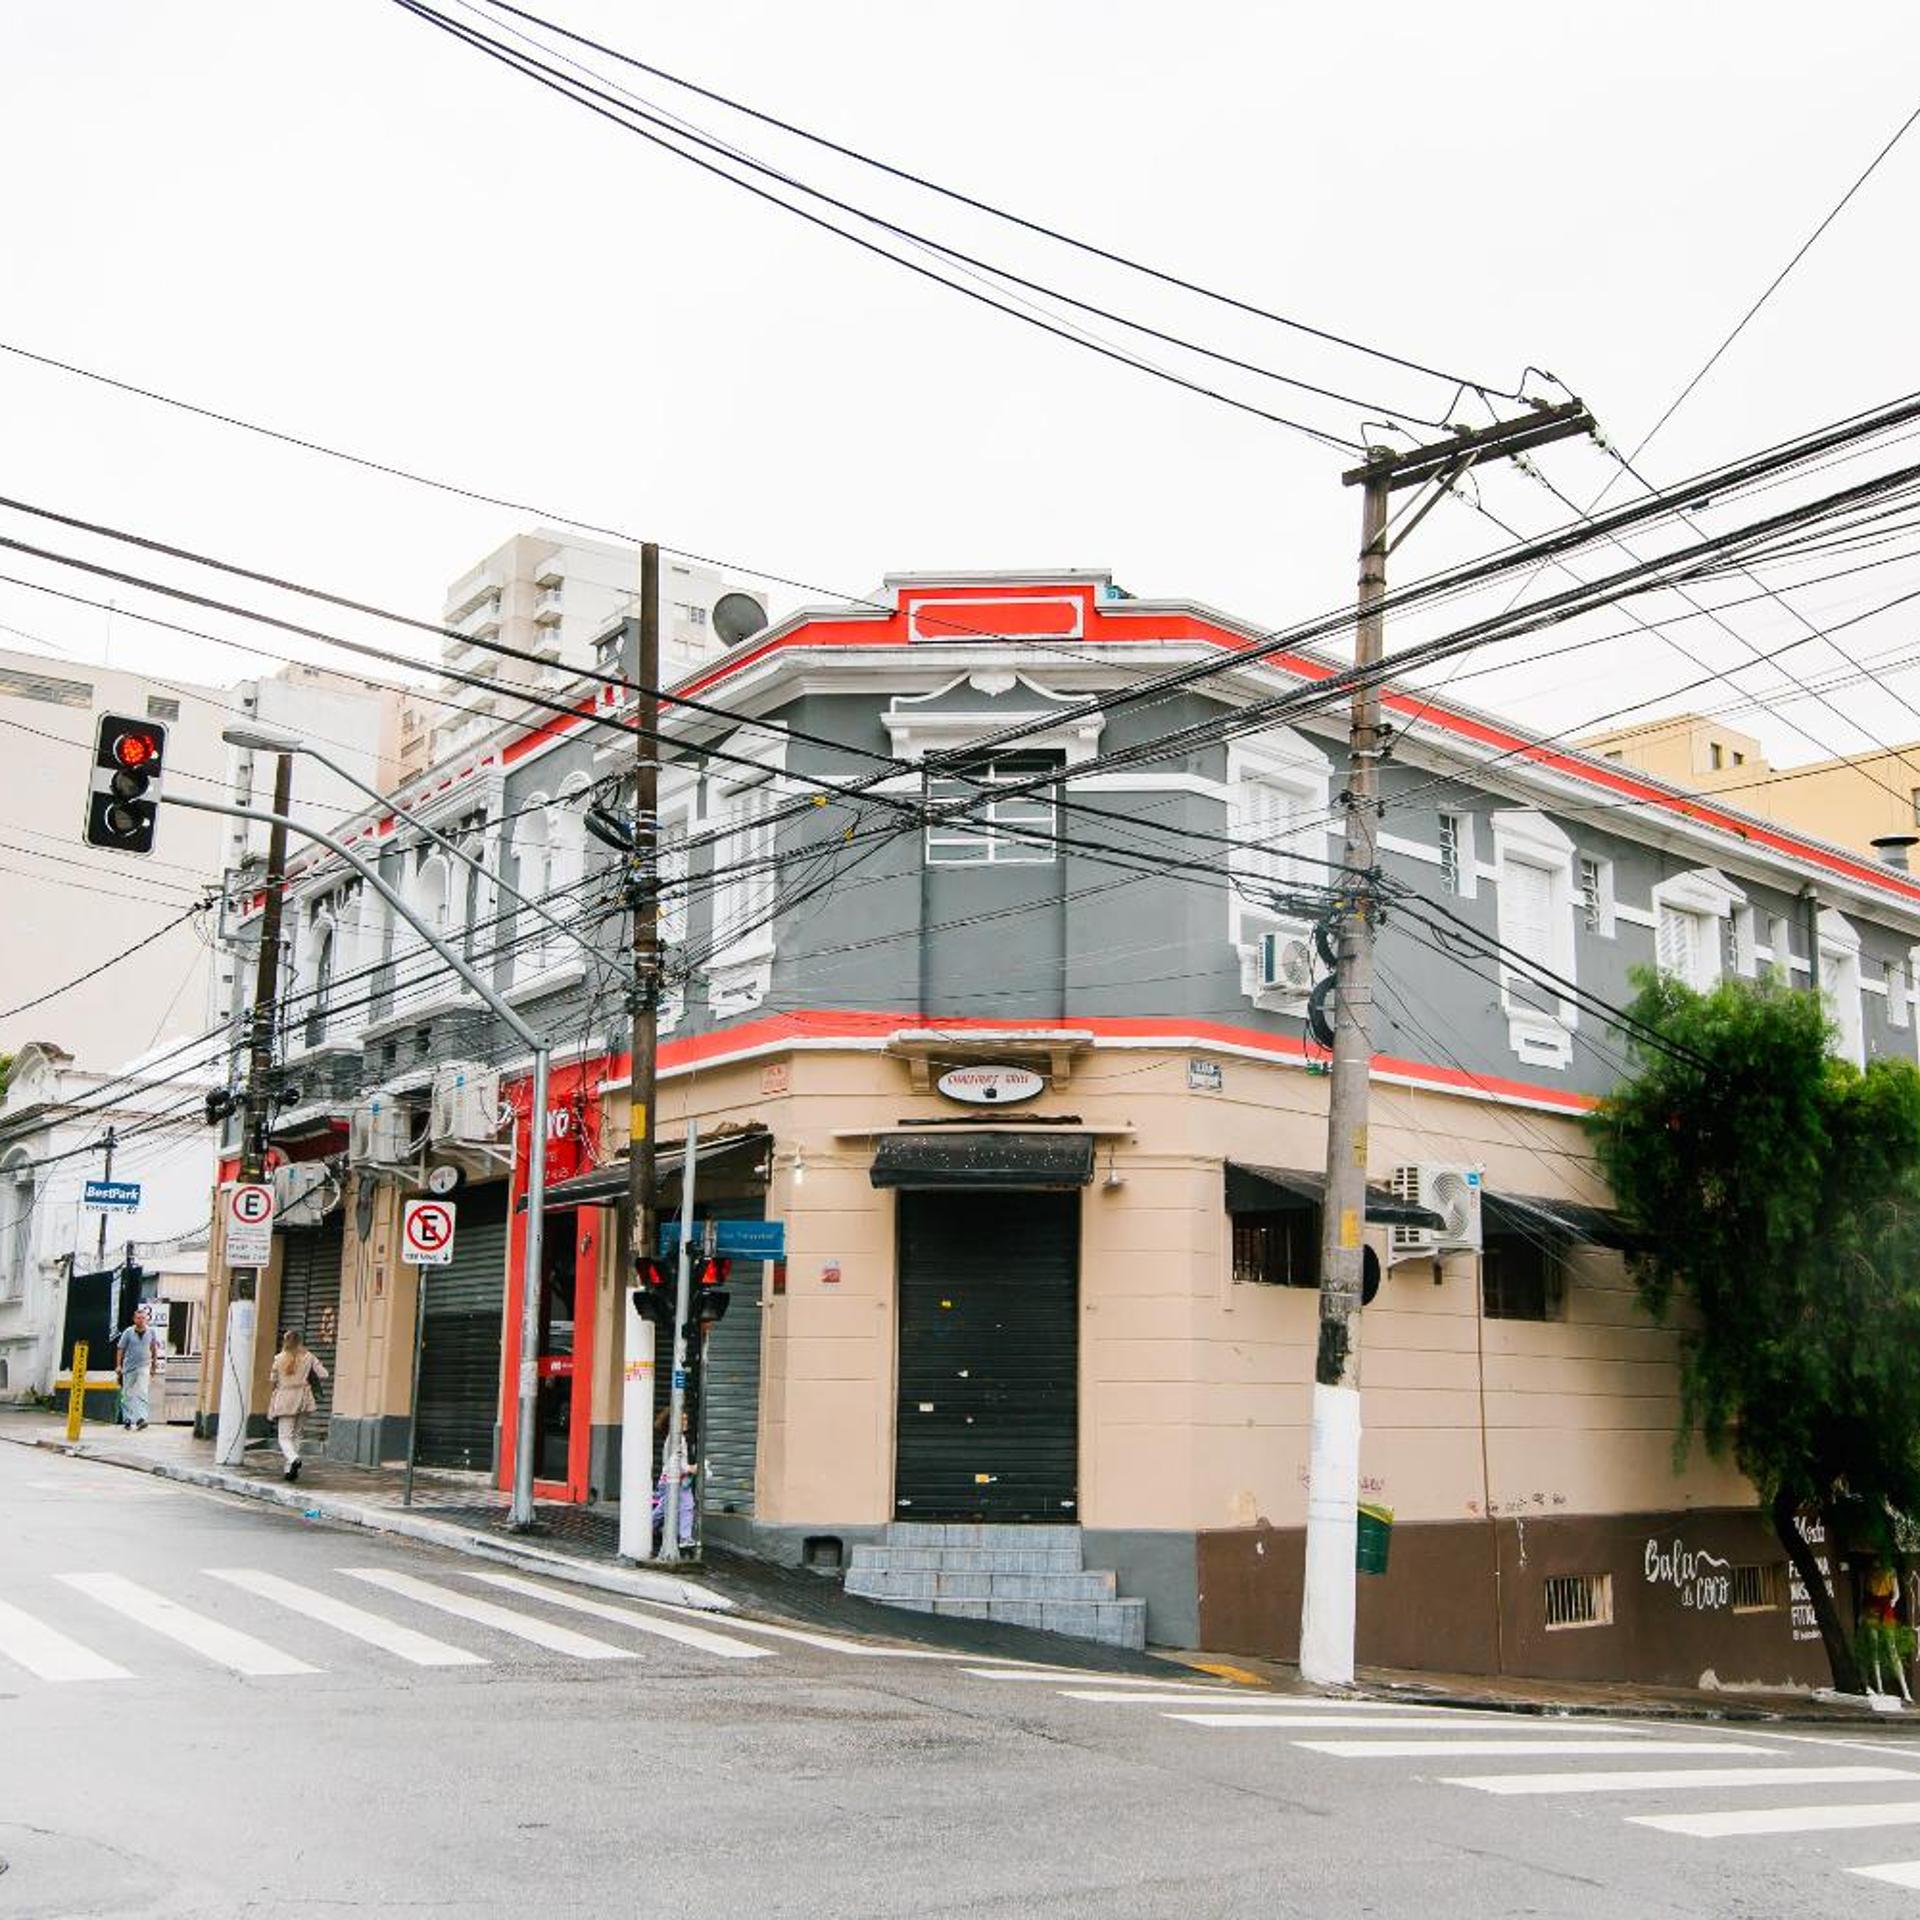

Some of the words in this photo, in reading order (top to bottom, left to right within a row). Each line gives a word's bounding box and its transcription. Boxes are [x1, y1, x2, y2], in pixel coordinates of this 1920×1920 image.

[86, 1186, 139, 1200] BestPark
[245, 1194, 259, 1216] E
[1644, 1538, 1697, 1588] Bala
